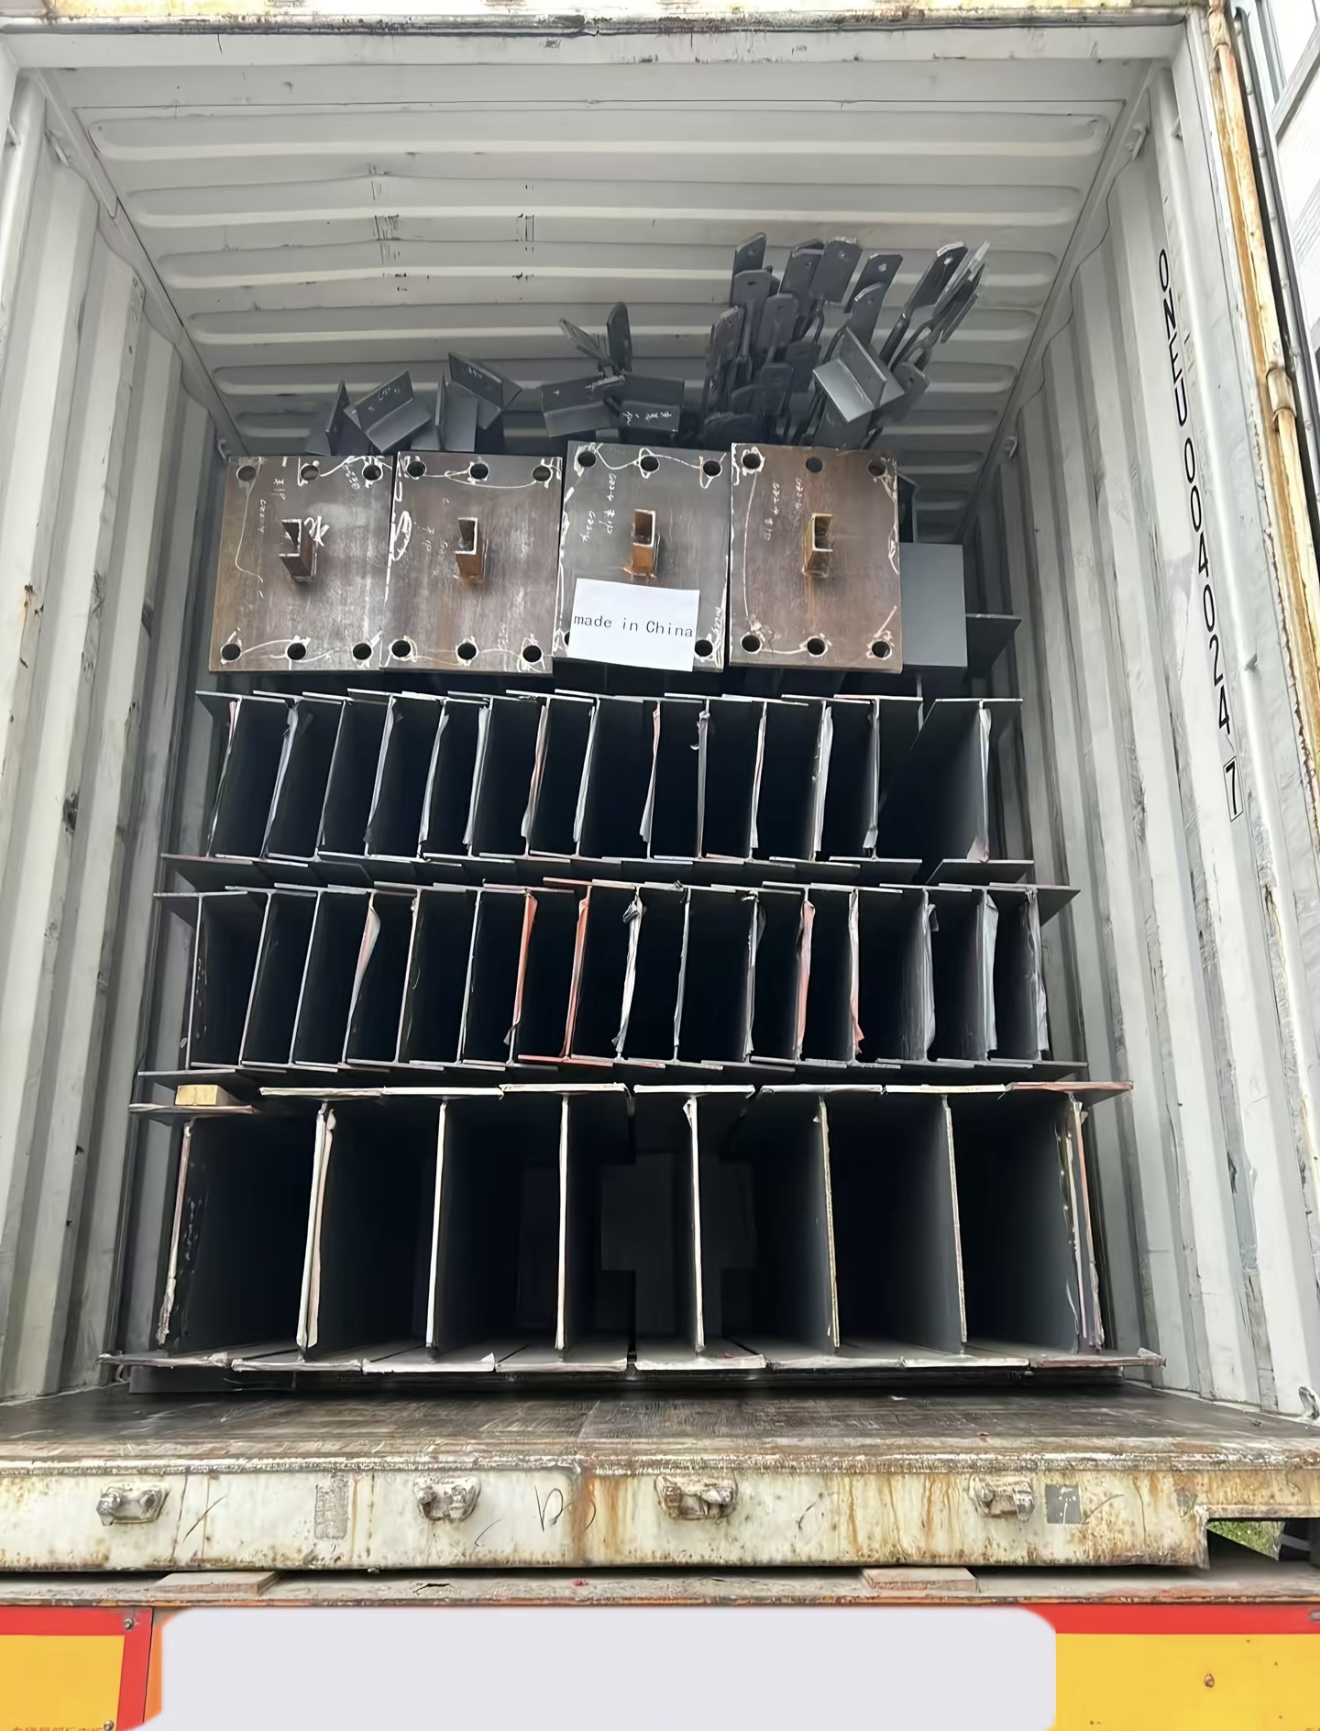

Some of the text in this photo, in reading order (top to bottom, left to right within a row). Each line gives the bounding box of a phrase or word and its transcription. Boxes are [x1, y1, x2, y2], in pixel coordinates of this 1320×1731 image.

[573, 614, 613, 629] made
[622, 617, 639, 632] in
[645, 620, 694, 638] China
